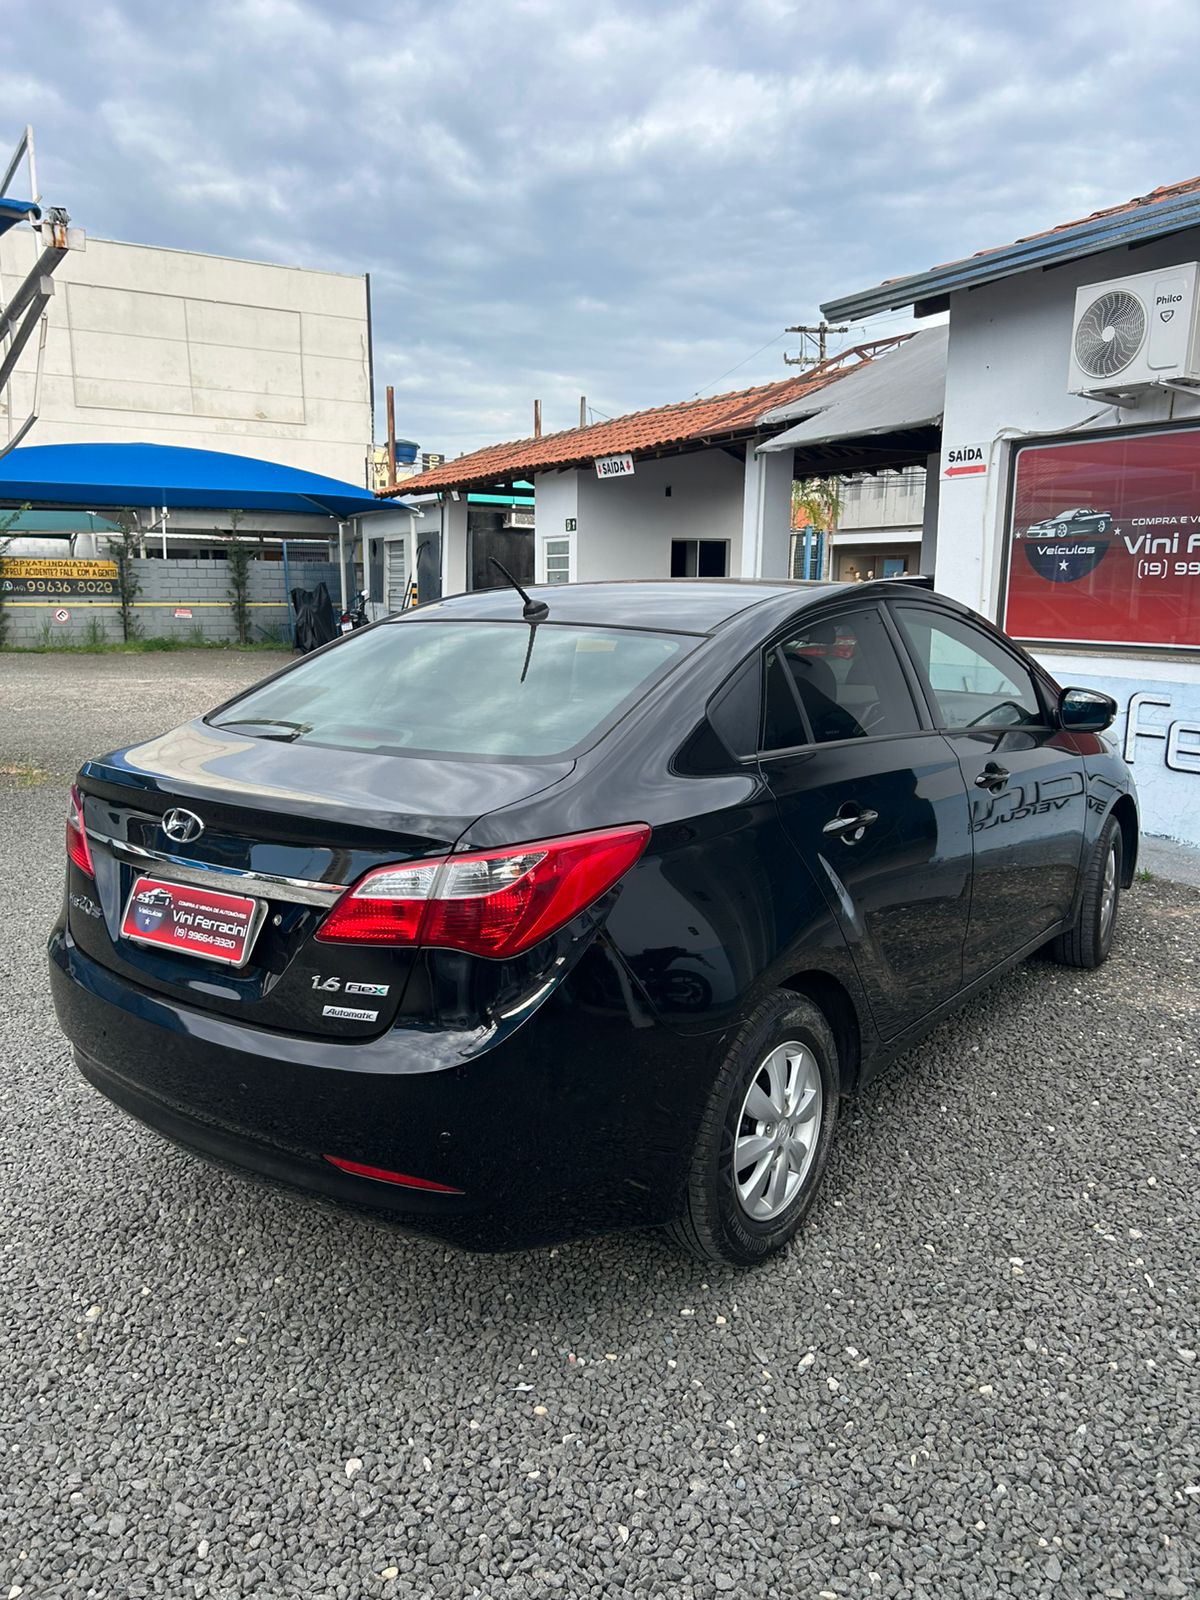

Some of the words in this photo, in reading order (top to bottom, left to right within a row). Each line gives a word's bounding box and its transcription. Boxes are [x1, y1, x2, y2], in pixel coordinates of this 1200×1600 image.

[1156, 294, 1183, 306] Philco
[948, 446, 983, 463] SAÍDA
[602, 458, 626, 475] SAÍDA
[1131, 516, 1178, 526] COMPRA
[1180, 516, 1188, 524] E
[1190, 515, 1200, 523] V
[1037, 544, 1096, 556] Veículos
[1123, 532, 1180, 555] Vini
[60, 568, 74, 577] FALE
[77, 568, 91, 577] COM
[1137, 559, 1168, 579] (19)
[173, 909, 195, 925] Vini
[194, 915, 248, 938] Ferracini
[174, 925, 188, 940] (19)
[187, 930, 236, 949] 99664-3320
[311, 974, 341, 992] 1.6
[326, 1007, 375, 1020] Automatic
